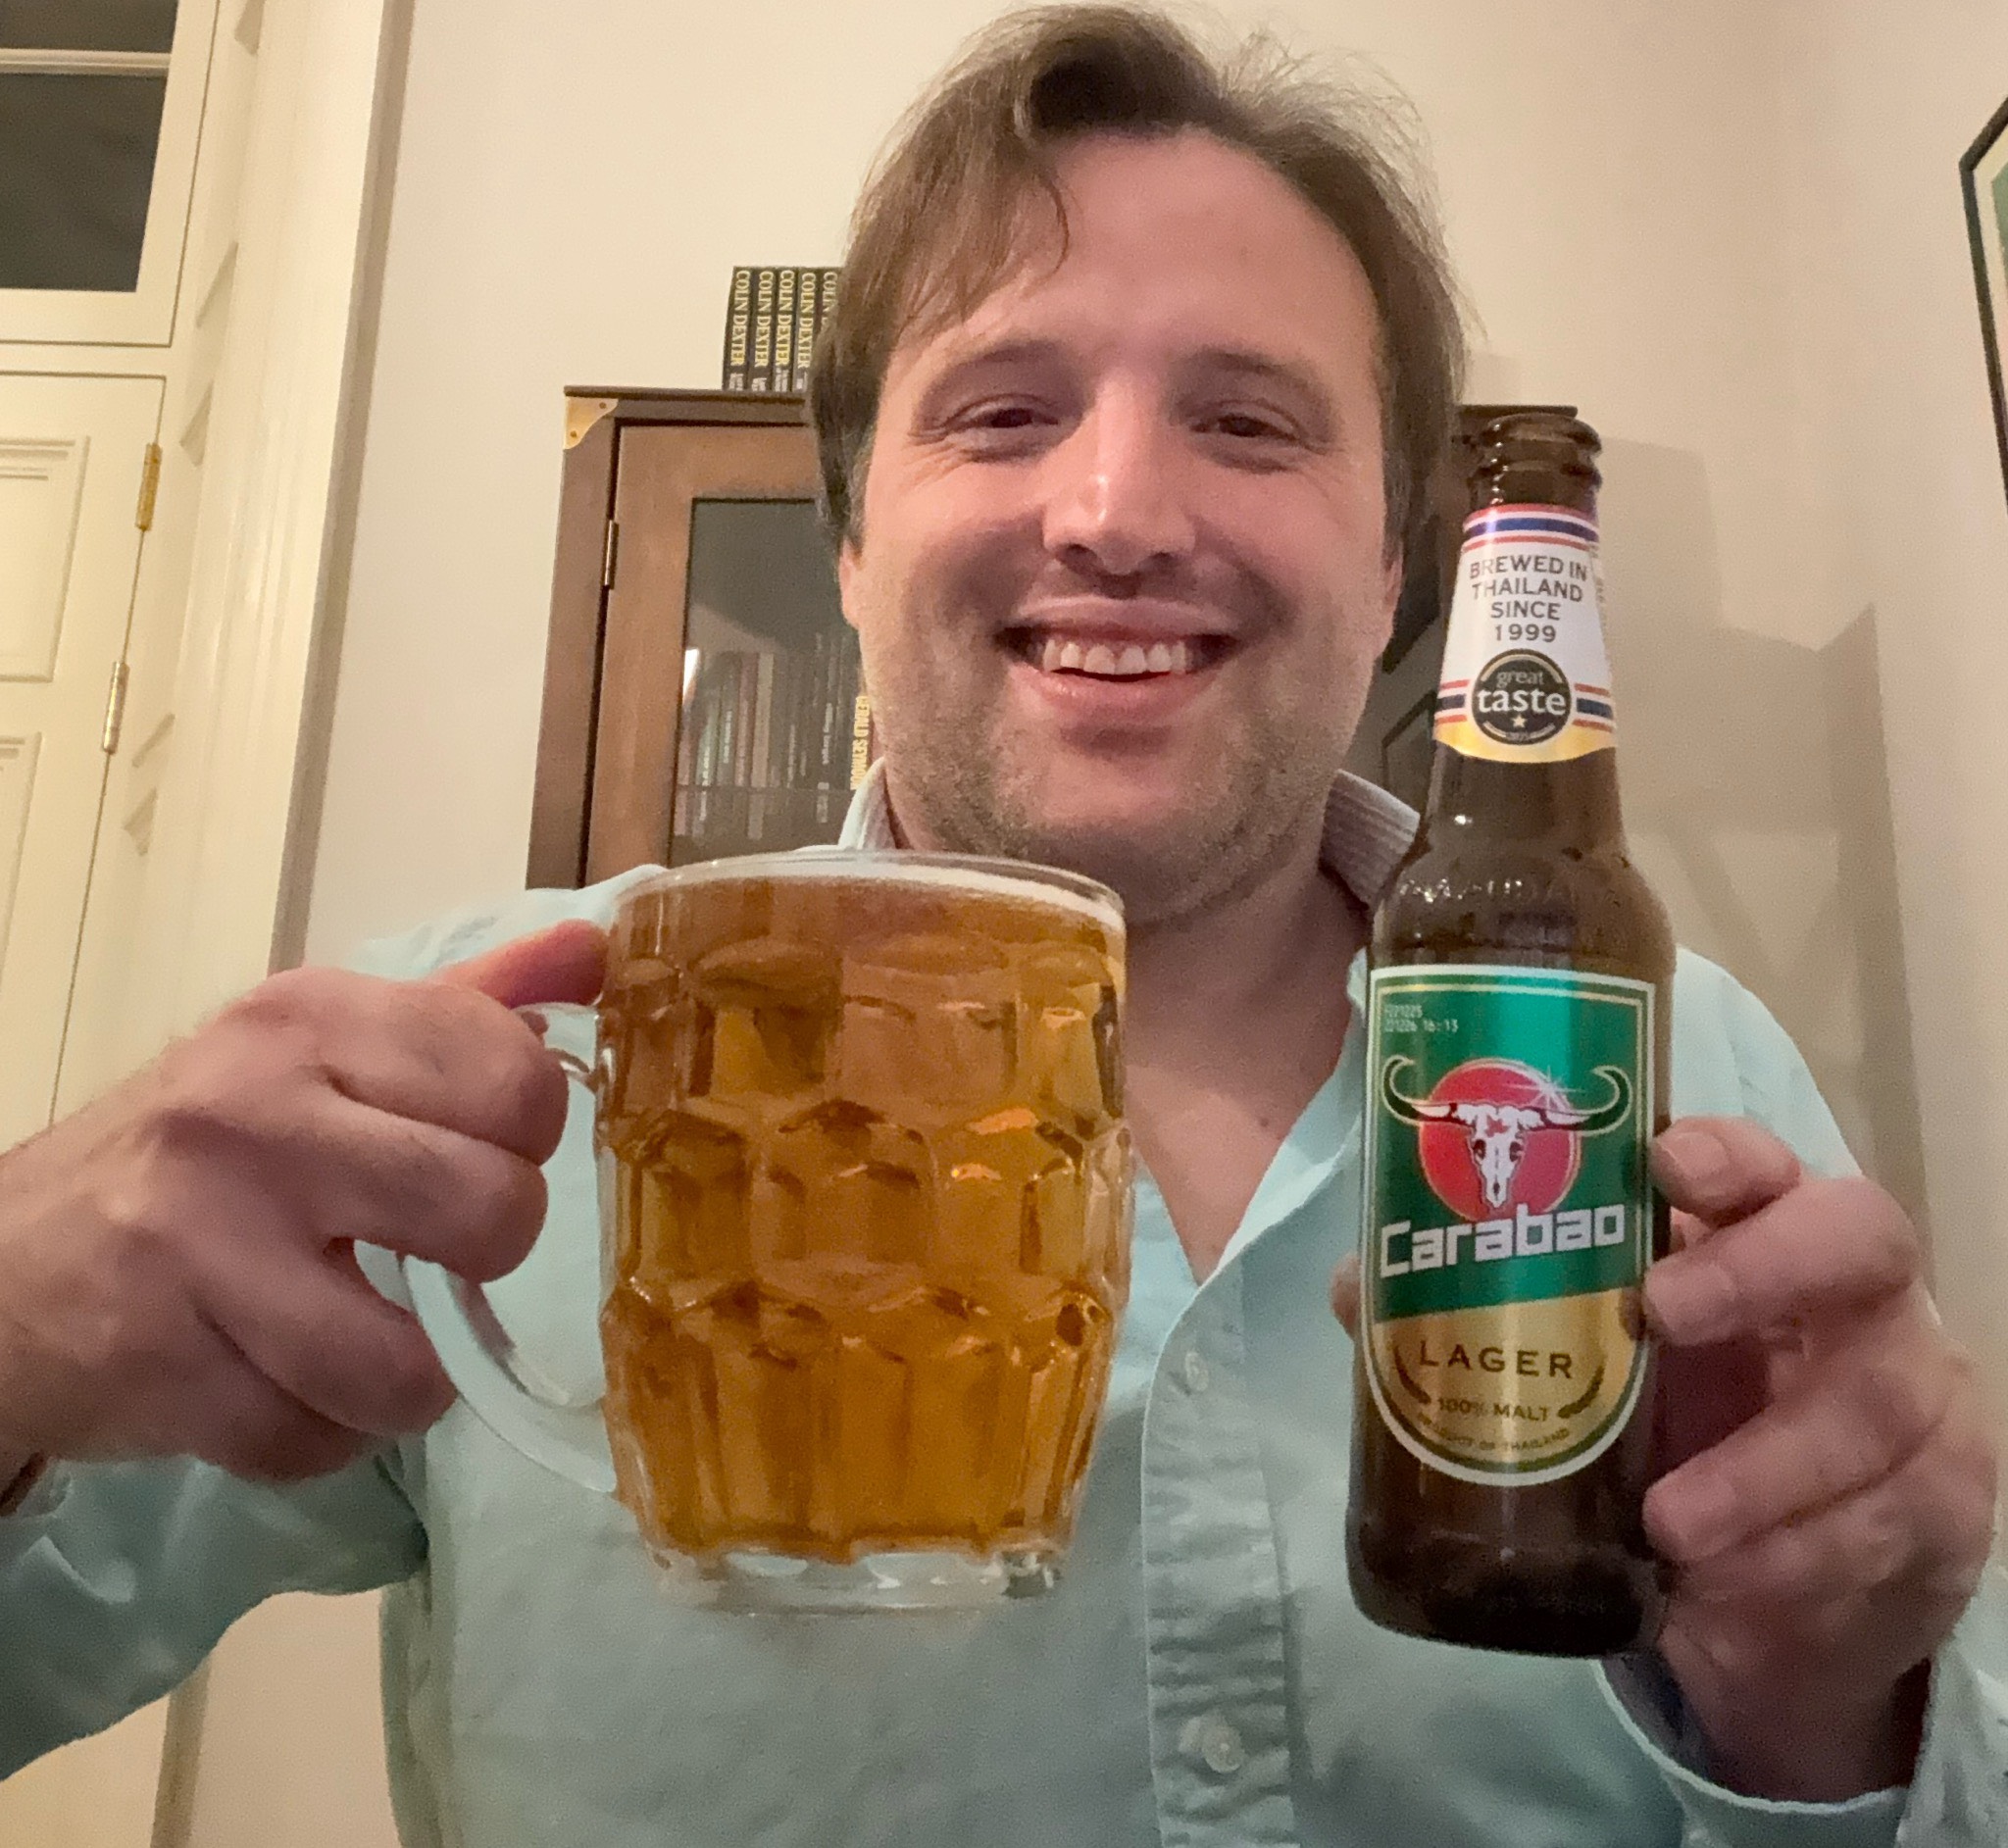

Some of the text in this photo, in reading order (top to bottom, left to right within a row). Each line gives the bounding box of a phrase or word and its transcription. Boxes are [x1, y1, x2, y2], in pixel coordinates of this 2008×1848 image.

[734, 270, 751, 311] COLIN
[758, 271, 774, 312] COLIN
[778, 270, 795, 311] COLIN
[801, 273, 816, 314] COLIN
[730, 315, 748, 366] DEXTER
[754, 316, 772, 368] DEXTER
[775, 315, 792, 366] DEXTER
[797, 318, 814, 369] DEXTER
[1470, 556, 1587, 581] BREWED IN
[1472, 577, 1583, 602] THAILAND
[1490, 600, 1561, 621] SINCE
[1495, 624, 1557, 642] 1999
[1496, 670, 1545, 688] great
[1476, 688, 1566, 716] taste
[1380, 1203, 1625, 1278] Carabao
[1421, 1340, 1573, 1379] LAGER
[1437, 1397, 1551, 1422] 100% MALT
